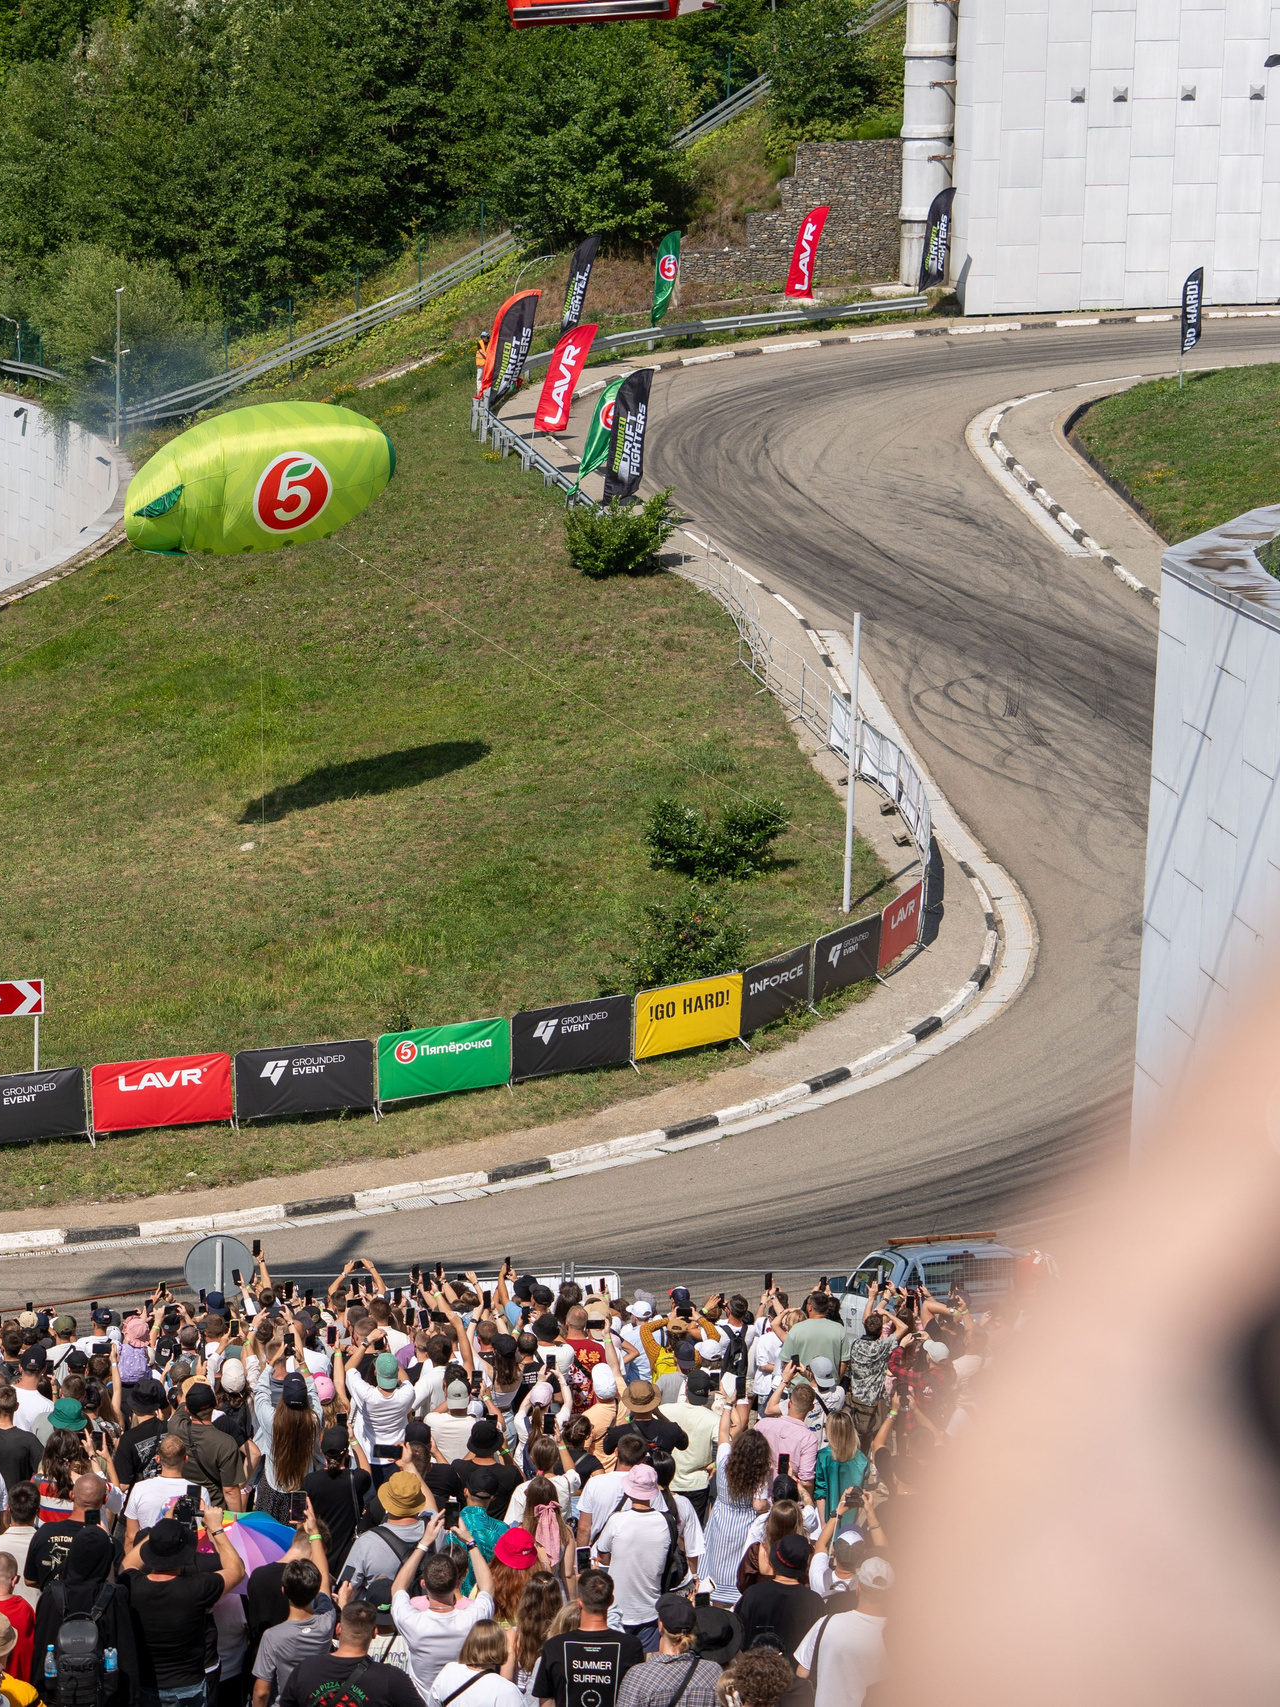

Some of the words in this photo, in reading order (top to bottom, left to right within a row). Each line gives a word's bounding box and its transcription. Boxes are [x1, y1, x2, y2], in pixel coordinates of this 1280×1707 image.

[794, 222, 817, 290] LAVR
[937, 213, 948, 271] FIGHTERS
[1186, 280, 1199, 323] HARD!
[492, 341, 512, 391] GROUNDED
[500, 336, 521, 388] DRIFT
[507, 326, 532, 388] FIGHTERS
[543, 345, 581, 425] LAVR
[611, 416, 626, 473] GROUNDED
[618, 411, 638, 478] DRIFT
[629, 402, 647, 477] FIGHTERS
[273, 459, 314, 521] 5
[891, 899, 916, 930] LAVR
[843, 931, 870, 948] GROUNDED
[843, 943, 859, 956] EVENT
[749, 963, 804, 996] INFORCE
[561, 1011, 608, 1025] GROUNDED
[649, 999, 677, 1022] !GO
[683, 989, 730, 1015] HARD!
[561, 1021, 590, 1034] EVENT
[291, 1054, 346, 1067] GROUNDED
[420, 1037, 492, 1057] Пятёрочка
[117, 1068, 203, 1093] LAVR
[292, 1063, 326, 1076] EVENT
[2, 1082, 57, 1097] GROUNDED
[3, 1093, 38, 1106] EVENT
[50, 1535, 73, 1543] TRITON
[572, 1660, 612, 1670] SUMMER
[573, 1674, 611, 1684] SURFING
[320, 1681, 340, 1692] PIZZA
